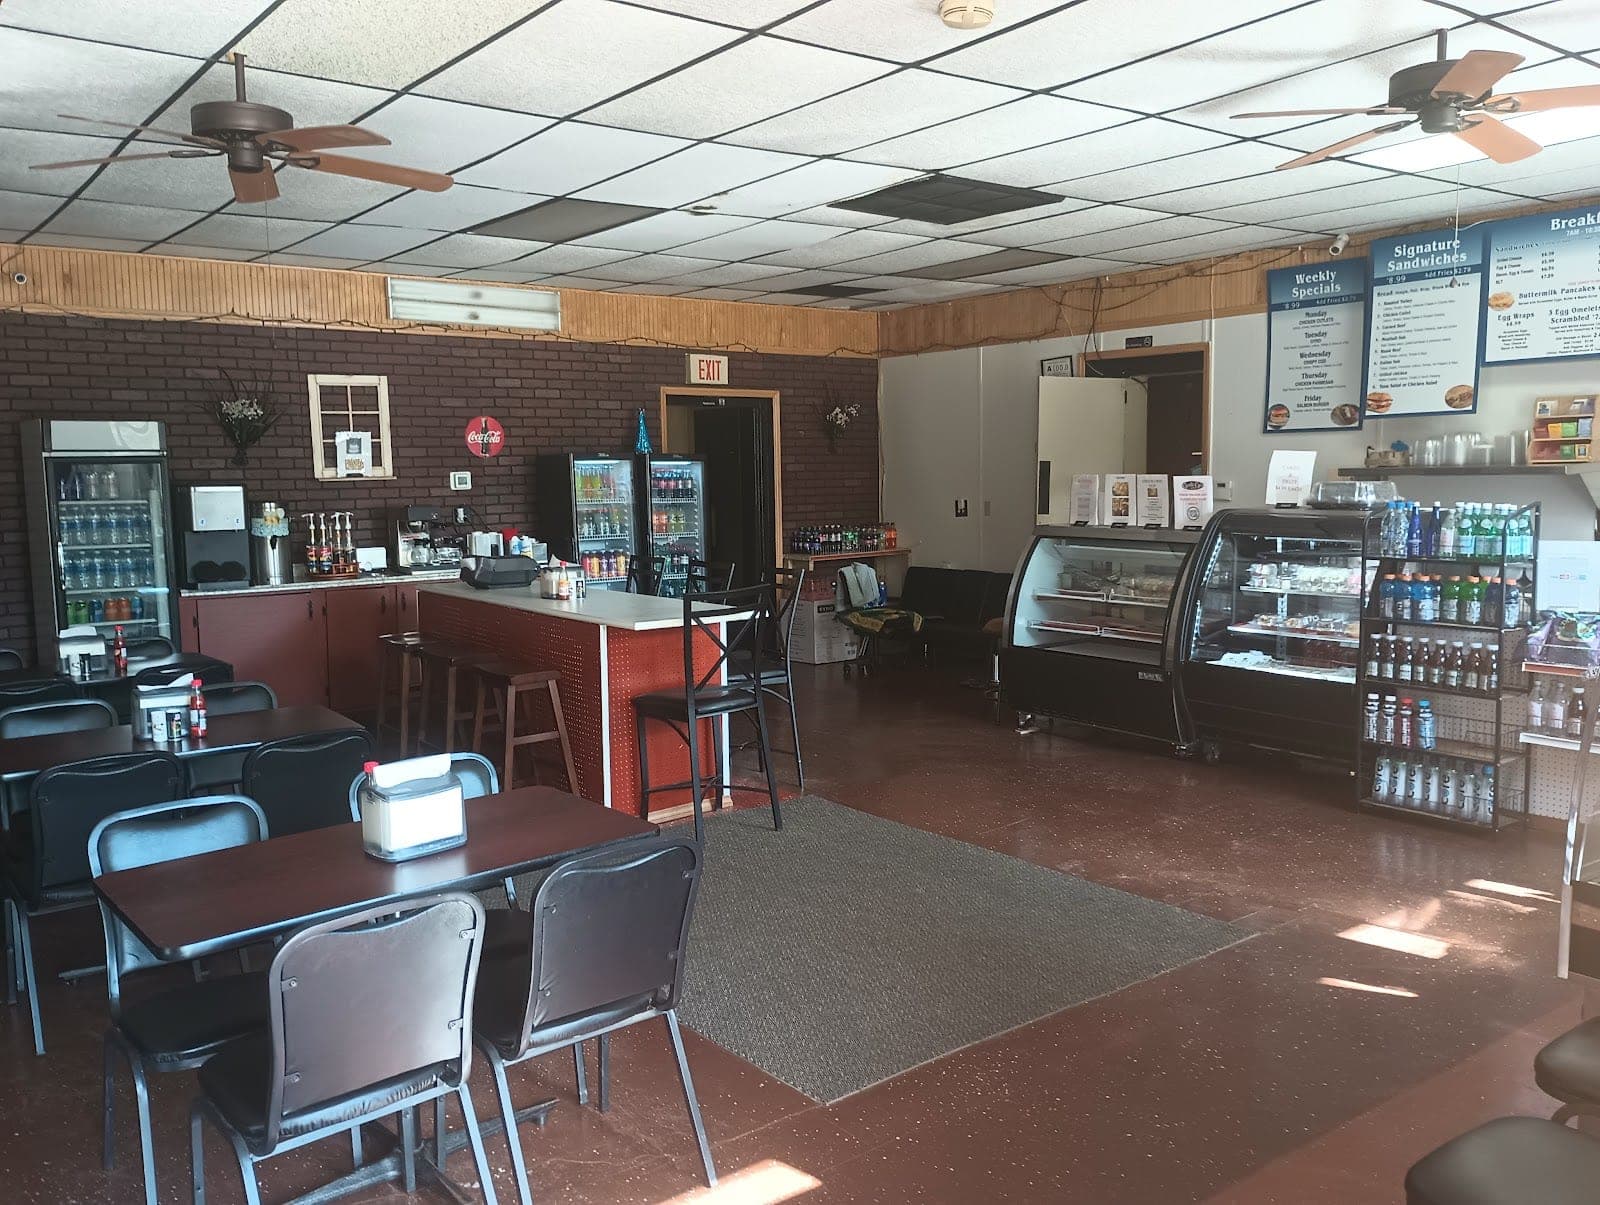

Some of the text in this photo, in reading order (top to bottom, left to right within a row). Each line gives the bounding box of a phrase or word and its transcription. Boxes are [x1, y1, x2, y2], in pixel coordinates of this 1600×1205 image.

[1394, 239, 1461, 258] Signature
[1387, 252, 1467, 272] Sandwiches
[1296, 270, 1336, 285] Weekly
[1292, 284, 1341, 300] Specials
[1519, 290, 1557, 300] Buttermilk
[1561, 286, 1596, 295] Pancakes
[1305, 311, 1327, 319] Monday
[1514, 312, 1535, 320] Wraps
[1555, 308, 1569, 316] Egg
[1551, 314, 1590, 324] Scrambled
[1305, 331, 1327, 339] Tuesday
[1300, 351, 1331, 359] Wednesday
[699, 360, 721, 381] EXIT
[1302, 372, 1327, 380] Thursday
[1305, 395, 1322, 403] Friday
[468, 431, 501, 443] Coca-Cola
